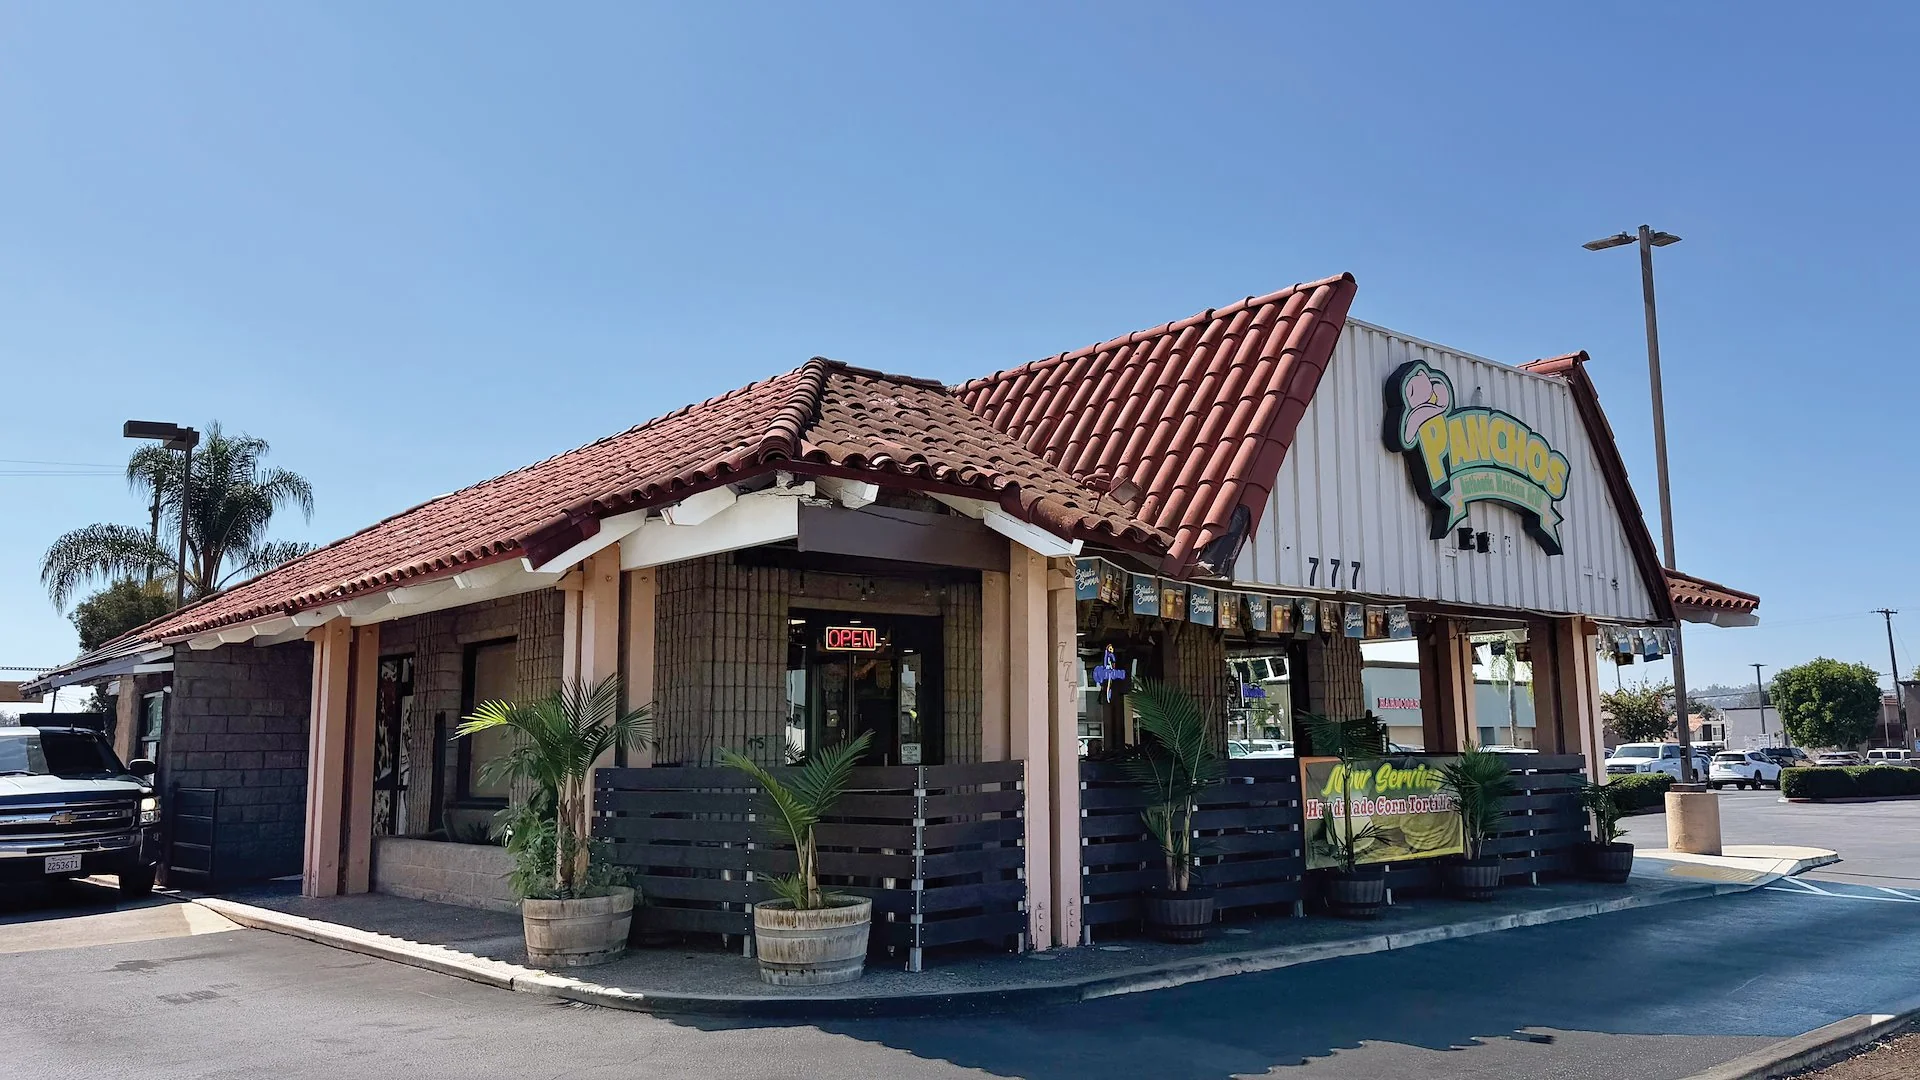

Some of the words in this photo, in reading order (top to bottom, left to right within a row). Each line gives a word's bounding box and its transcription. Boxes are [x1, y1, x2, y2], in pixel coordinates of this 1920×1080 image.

[1418, 414, 1567, 497] PANCHOS
[828, 629, 874, 648] OPEN
[1307, 797, 1374, 819] Hadade
[1375, 796, 1406, 816] Corn
